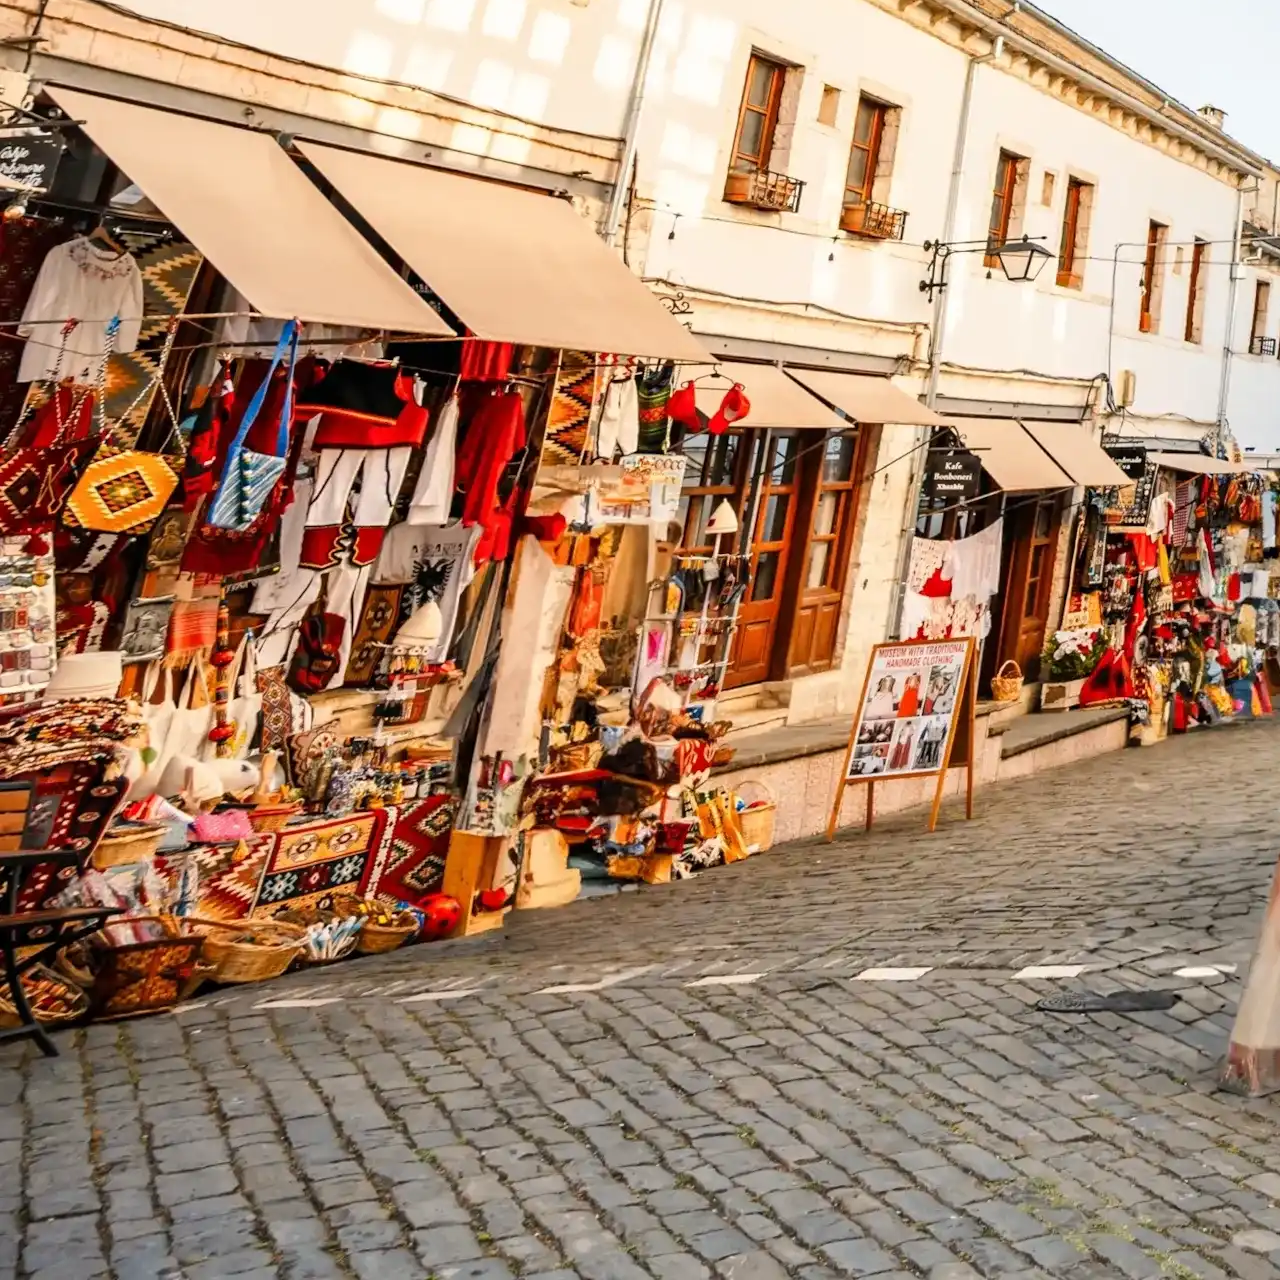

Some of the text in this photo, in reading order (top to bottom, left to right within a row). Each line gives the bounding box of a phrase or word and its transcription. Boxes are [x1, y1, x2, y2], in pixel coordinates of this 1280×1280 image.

[945, 461, 963, 470] Kafe
[933, 472, 973, 480] Bonboneri
[879, 643, 965, 658] MUSEUM WITH TRADITIONAL
[886, 654, 955, 668] HANDMADE CLOTHING
